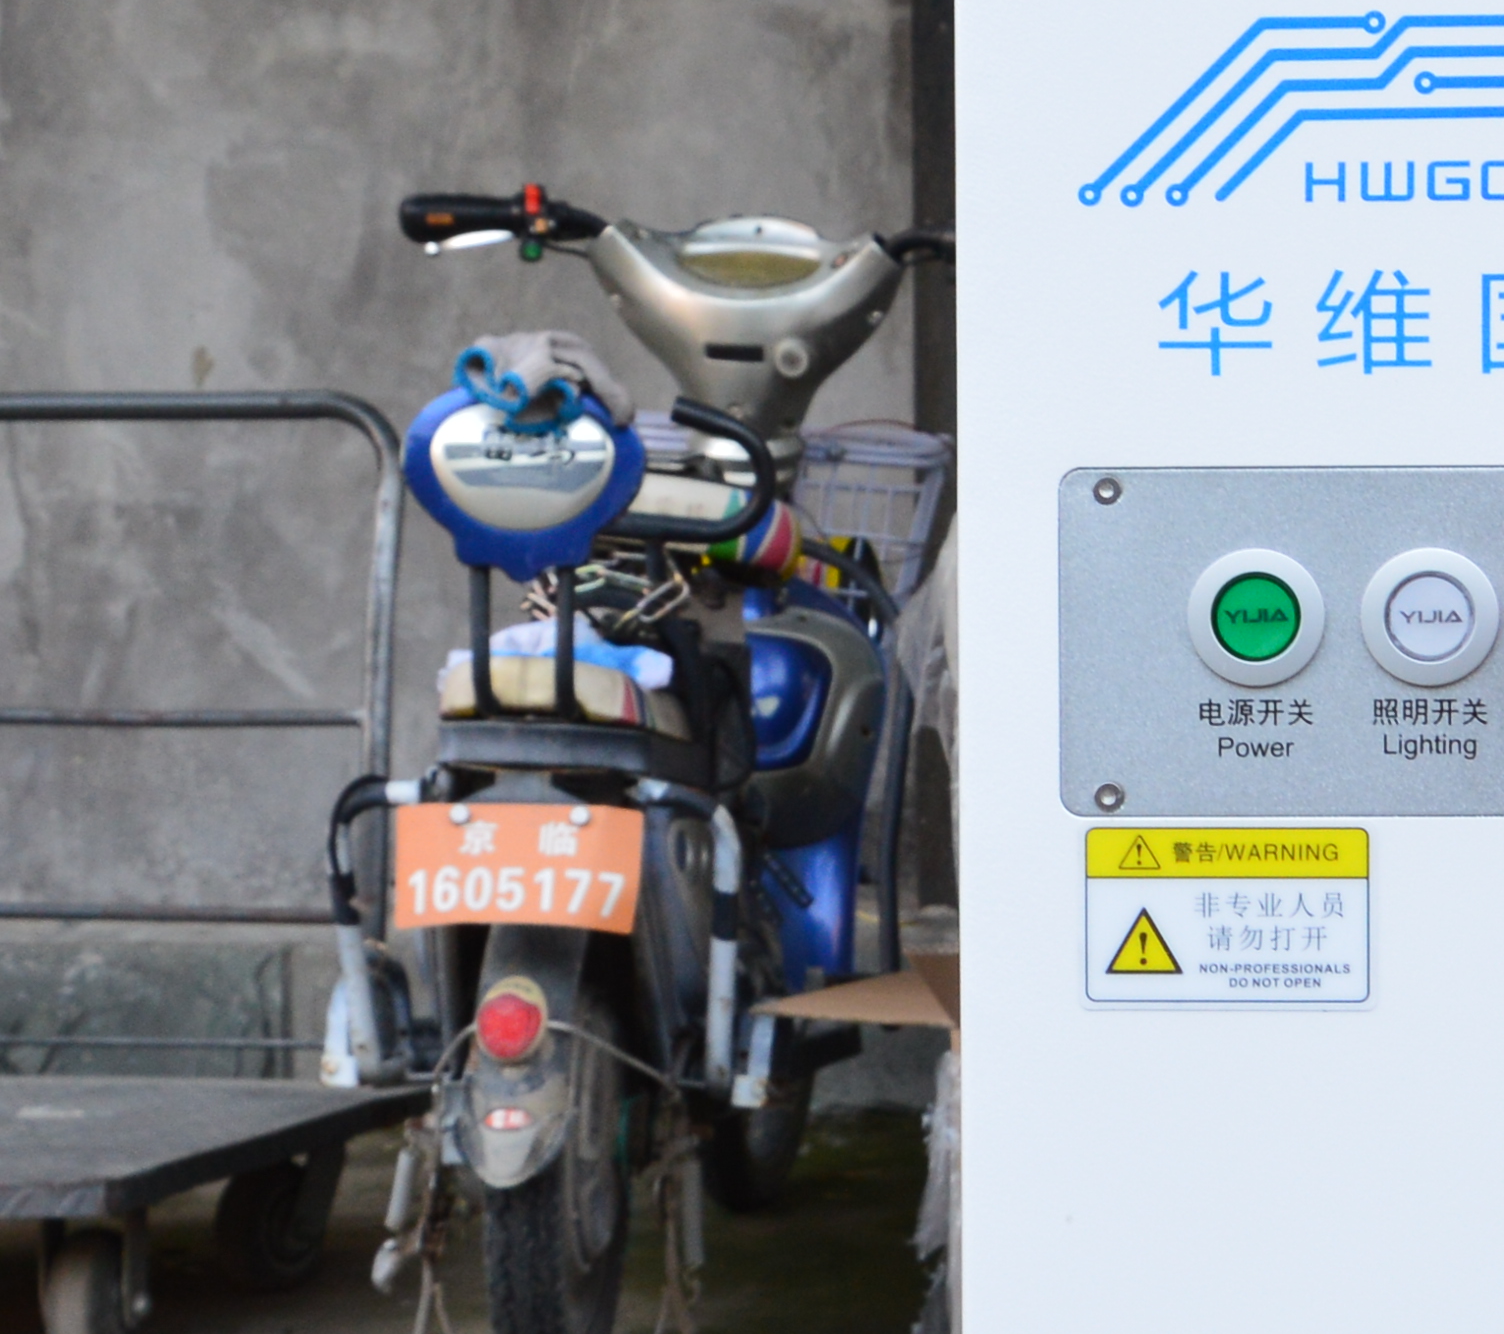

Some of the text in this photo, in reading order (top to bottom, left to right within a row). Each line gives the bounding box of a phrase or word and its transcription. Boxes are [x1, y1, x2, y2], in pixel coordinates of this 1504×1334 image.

[1198, 698, 1314, 727] 电源开关
[1372, 698, 1489, 727] 照明开关
[1218, 736, 1295, 758] Power
[1382, 733, 1479, 761] Lighting
[1172, 841, 1340, 864] 警告/WARNING
[407, 864, 626, 918] 1605177
[1194, 891, 1345, 919] 非专业人员
[1207, 925, 1328, 953] 请勿打开
[1199, 963, 1351, 975] NON-PROFESSIONALS
[1228, 977, 1323, 989] DO NOT OPEN
